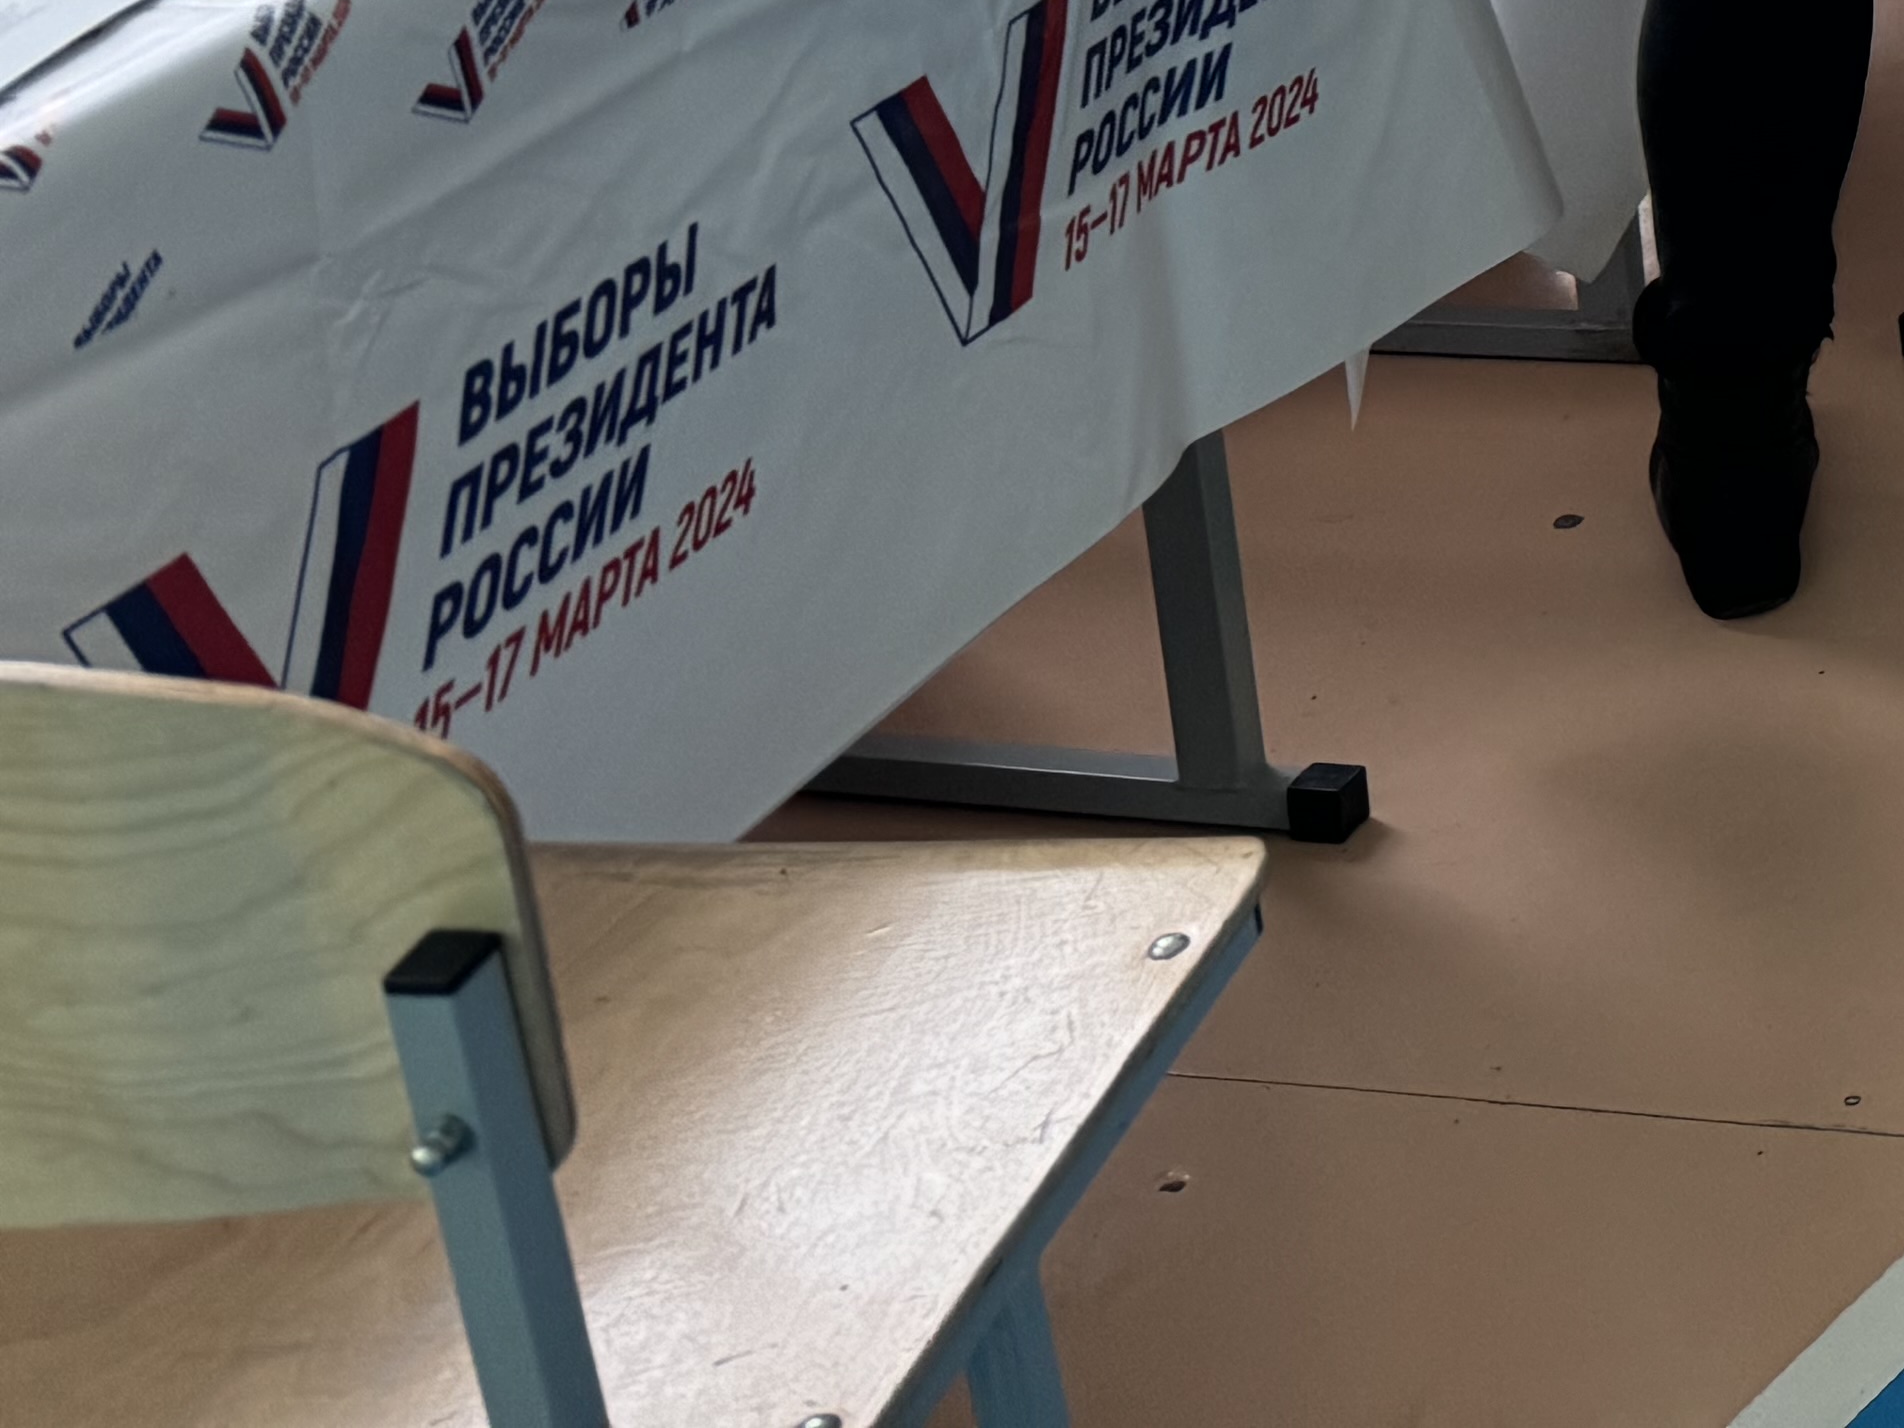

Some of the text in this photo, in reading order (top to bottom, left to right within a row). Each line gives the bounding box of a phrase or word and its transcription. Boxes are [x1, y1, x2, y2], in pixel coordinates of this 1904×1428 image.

[1067, 42, 1232, 197] РОССИИ
[1134, 111, 1241, 213] МАРТА
[1248, 66, 1319, 149] 2024
[440, 264, 778, 559] ПРЕЗИДЕНТА
[457, 222, 699, 446] ВЫБОРЫ
[422, 445, 651, 671] РОССИИ
[530, 527, 660, 677] МАРТА
[668, 458, 757, 572] 2024
